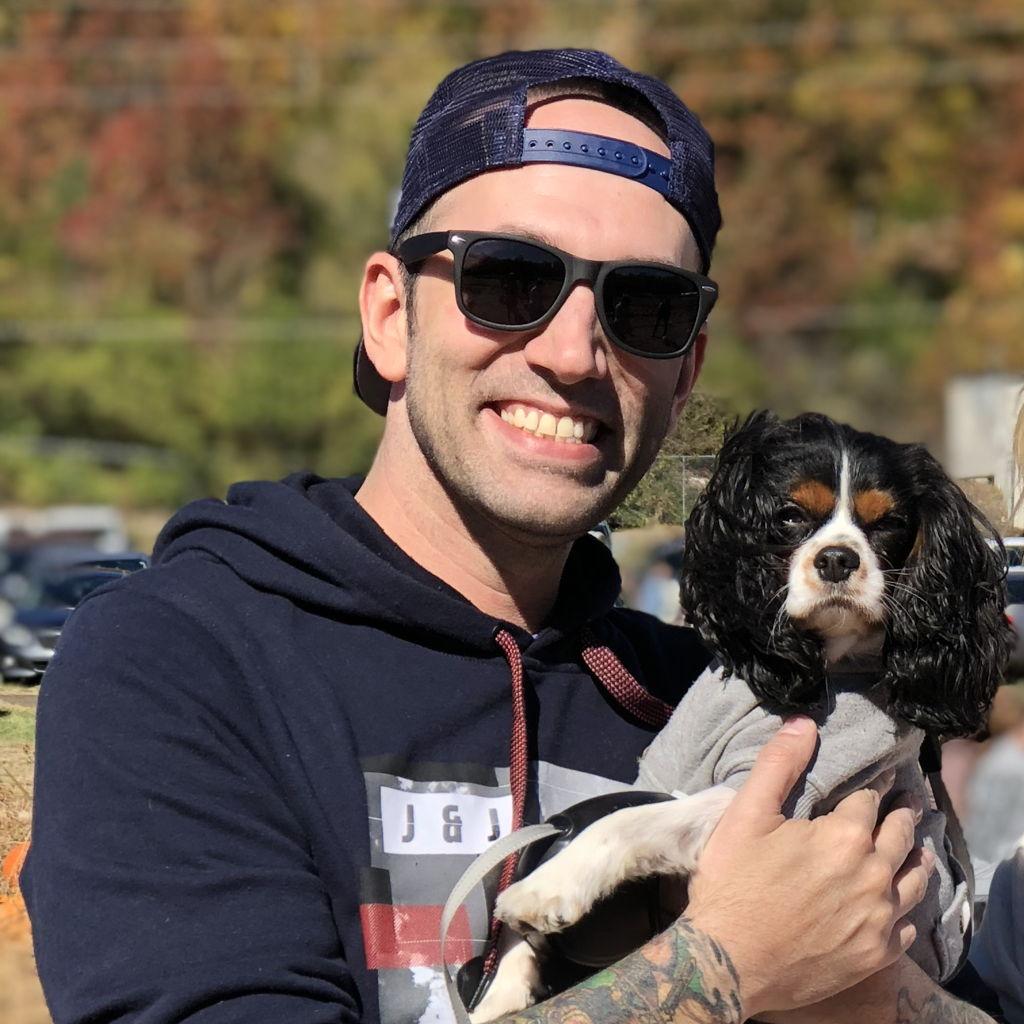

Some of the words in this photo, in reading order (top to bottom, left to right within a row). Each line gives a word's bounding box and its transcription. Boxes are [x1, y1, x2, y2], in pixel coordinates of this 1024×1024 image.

[402, 804, 415, 843] J
[442, 805, 462, 843] &
[487, 808, 501, 842] J
